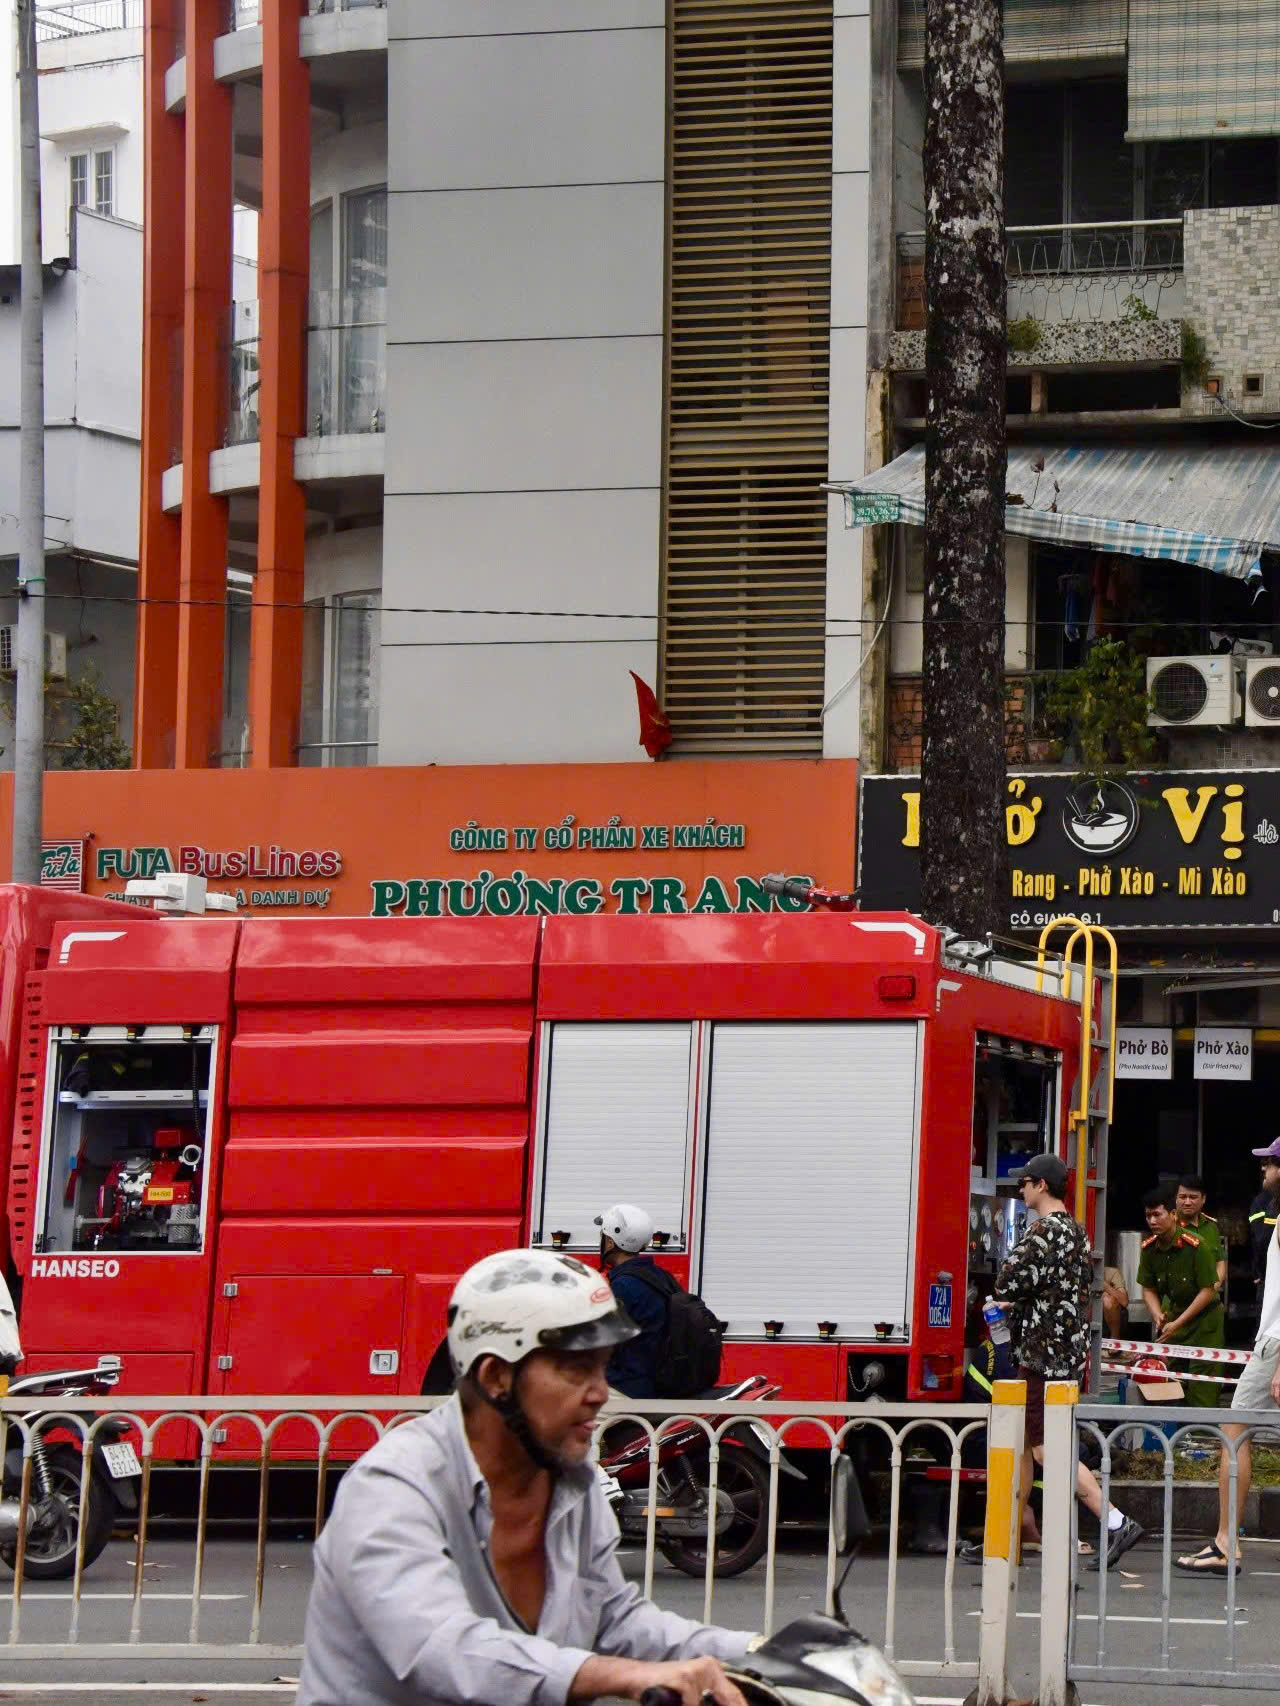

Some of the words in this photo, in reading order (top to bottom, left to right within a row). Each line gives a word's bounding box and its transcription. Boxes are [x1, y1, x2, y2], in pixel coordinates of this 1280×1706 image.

[450, 821, 508, 851] CÔNG
[513, 827, 539, 850] TY
[543, 815, 574, 850] CỔ
[577, 816, 636, 849] PHẦN
[641, 825, 669, 848] XE
[673, 817, 746, 848] KHÁCH
[1161, 784, 1248, 860] Vị
[1253, 819, 1279, 844] Hà
[96, 847, 174, 879] FUTA
[370, 870, 604, 917] PHƯƠNG
[1012, 868, 1056, 900] Rang
[1078, 864, 1111, 896] Phở
[1120, 867, 1154, 895] Xào
[1178, 868, 1202, 895] Mì
[1211, 867, 1247, 895] Xào
[251, 890, 299, 905] DANH
[303, 888, 331, 908] DỰ
[1010, 910, 1031, 925] CÔ
[1080, 912, 1101, 925] Q.1
[1118, 1039, 1148, 1056] Phở
[1151, 1040, 1169, 1056] Bò
[1196, 1041, 1223, 1056] Phở
[1225, 1041, 1249, 1056] Xào
[31, 1259, 120, 1278] HANSEO
